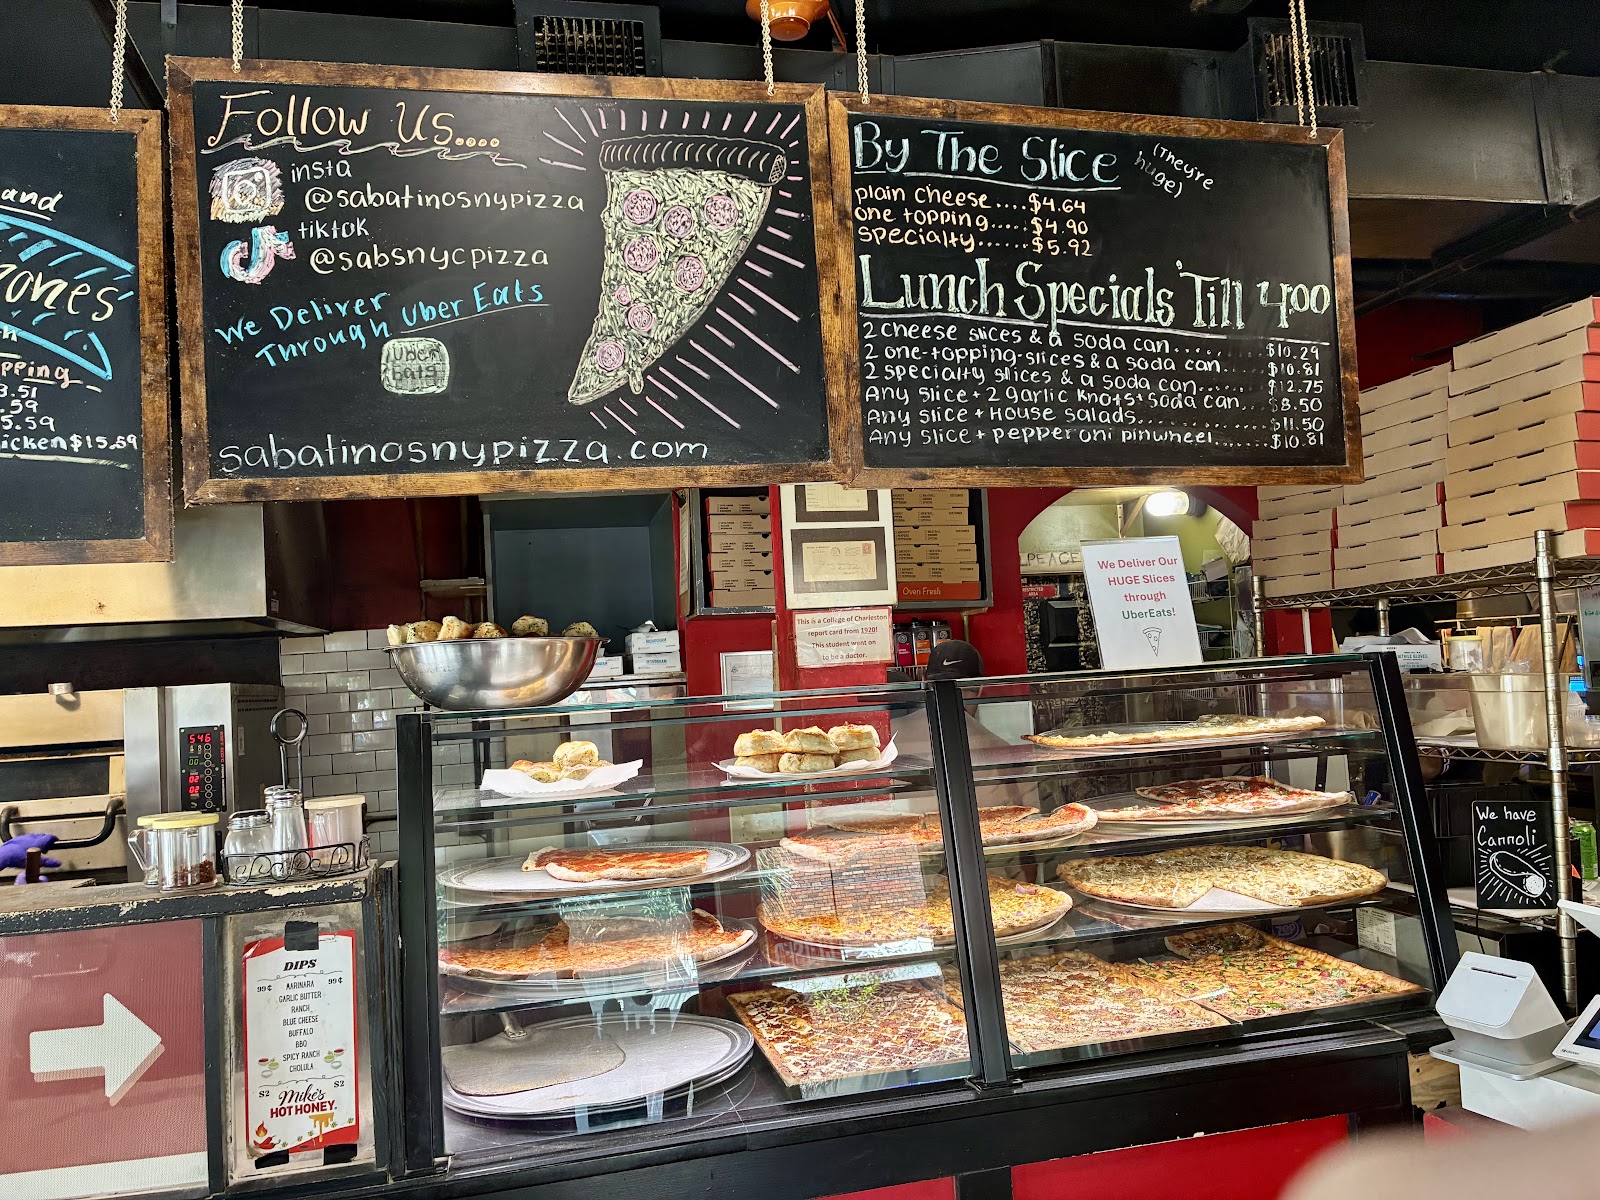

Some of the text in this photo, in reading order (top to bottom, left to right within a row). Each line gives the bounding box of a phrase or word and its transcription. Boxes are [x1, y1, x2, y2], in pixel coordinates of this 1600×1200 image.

[207, 90, 370, 147] Follow
[853, 121, 1120, 183] By The Slice
[290, 159, 352, 183] insta
[1134, 150, 1183, 199] huge)
[1, 187, 64, 213] and
[304, 183, 585, 213] @sabatinosnypizza
[854, 184, 1086, 215] plain cheese $4.64
[297, 216, 370, 240] tiktok
[854, 206, 1089, 236] one topping $4.90
[858, 225, 1092, 257] specialty $5.92
[309, 241, 549, 275] @sabsnycpizza
[858, 254, 1008, 317] Lunch
[1013, 259, 1175, 336] Specials
[214, 291, 391, 345] We Deliver
[254, 278, 545, 368] Through Uber Eats
[862, 321, 1320, 361] 2 cheese slices & a soda can $10.29
[863, 343, 878, 360] 2
[1090, 354, 1101, 369] &
[1105, 356, 1120, 370] a
[1125, 355, 1176, 371] soda
[1184, 358, 1221, 374] can
[1266, 361, 1320, 377] $10.81
[864, 361, 1324, 395] 2 specialty slices & a soda can $12.75
[864, 385, 910, 405] Any
[917, 384, 969, 403] slice
[971, 390, 981, 400] +
[987, 386, 1001, 402] 2
[1005, 387, 1069, 404] garlic
[1203, 394, 1240, 410] can
[1267, 397, 1323, 413] $8.50
[866, 408, 911, 427] Any
[917, 407, 969, 423] slice
[974, 409, 984, 419] +
[1064, 406, 1137, 424] salads
[1270, 416, 1325, 433] $11.50
[69, 433, 139, 453] $15.59
[868, 429, 912, 448] Any
[921, 428, 972, 445] slice
[975, 431, 985, 441] +
[1121, 427, 1212, 444] pinwheel
[1270, 433, 1325, 450] $10.81
[218, 433, 709, 473] sabatinosnypizza.com
[1027, 551, 1082, 566] PEACE
[1097, 556, 1178, 570] We Deliver Our
[1107, 574, 1176, 586] HUGE Slices
[902, 586, 942, 595] Oven Fresh
[1123, 591, 1167, 603] through
[797, 617, 810, 625] This
[822, 616, 846, 625] College
[854, 614, 888, 622] Charleston
[1121, 607, 1176, 620] UberEats!
[808, 629, 828, 637] report
[861, 627, 878, 635] 1920!
[812, 641, 825, 649] This
[825, 640, 850, 648] student
[189, 733, 212, 744] 546
[188, 758, 199, 766] 00
[188, 775, 200, 783] 02
[188, 786, 200, 794] 02
[1475, 805, 1537, 822] We have
[1477, 825, 1537, 846] Cannoli
[283, 958, 317, 971] DIPS
[278, 991, 322, 1003] GARLIC BUTTER
[291, 1004, 310, 1013] RANCH
[282, 1015, 319, 1026] BLUE CHEESE
[288, 1027, 314, 1037] BUFFALO
[282, 1049, 321, 1061] SPICY RANCH
[289, 1062, 314, 1073] CHOLULA
[278, 1083, 326, 1106] Mike's
[270, 1100, 335, 1118] HOT HONEY
